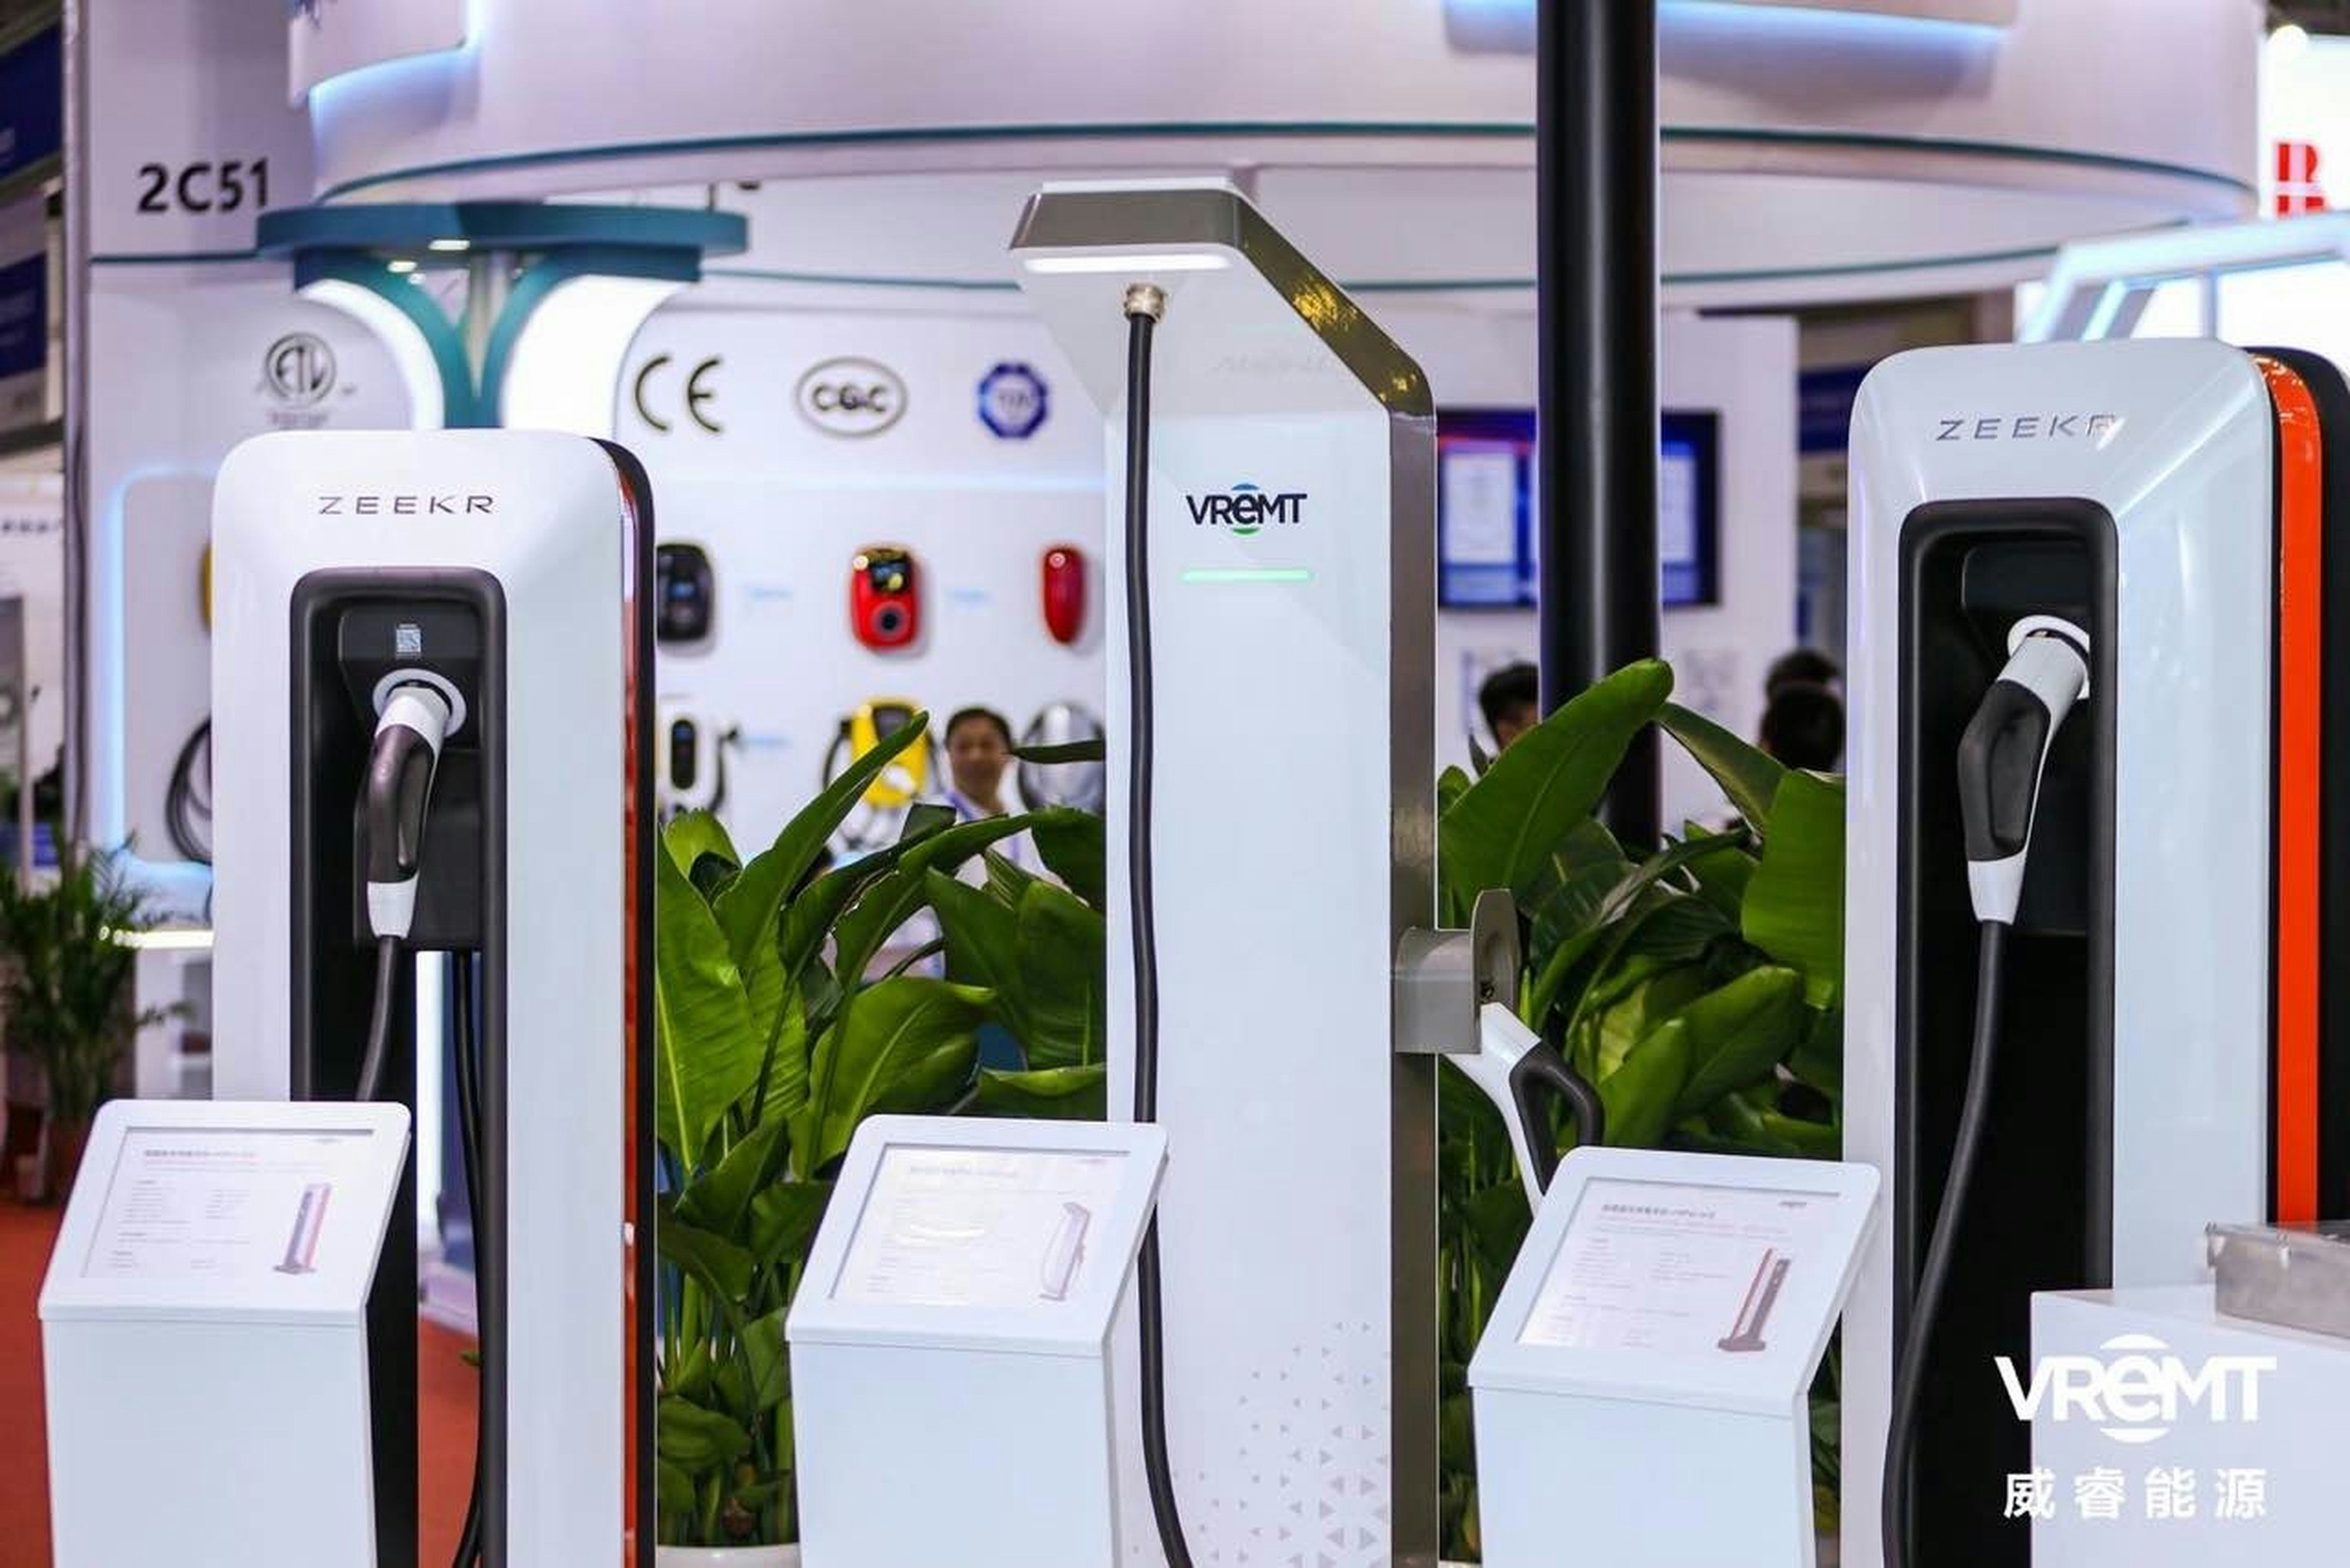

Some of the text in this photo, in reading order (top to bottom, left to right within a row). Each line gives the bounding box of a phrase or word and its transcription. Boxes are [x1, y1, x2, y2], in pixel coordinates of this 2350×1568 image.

[136, 159, 269, 214] 2C51
[635, 354, 724, 434] CE
[319, 495, 499, 515] ZEEKR
